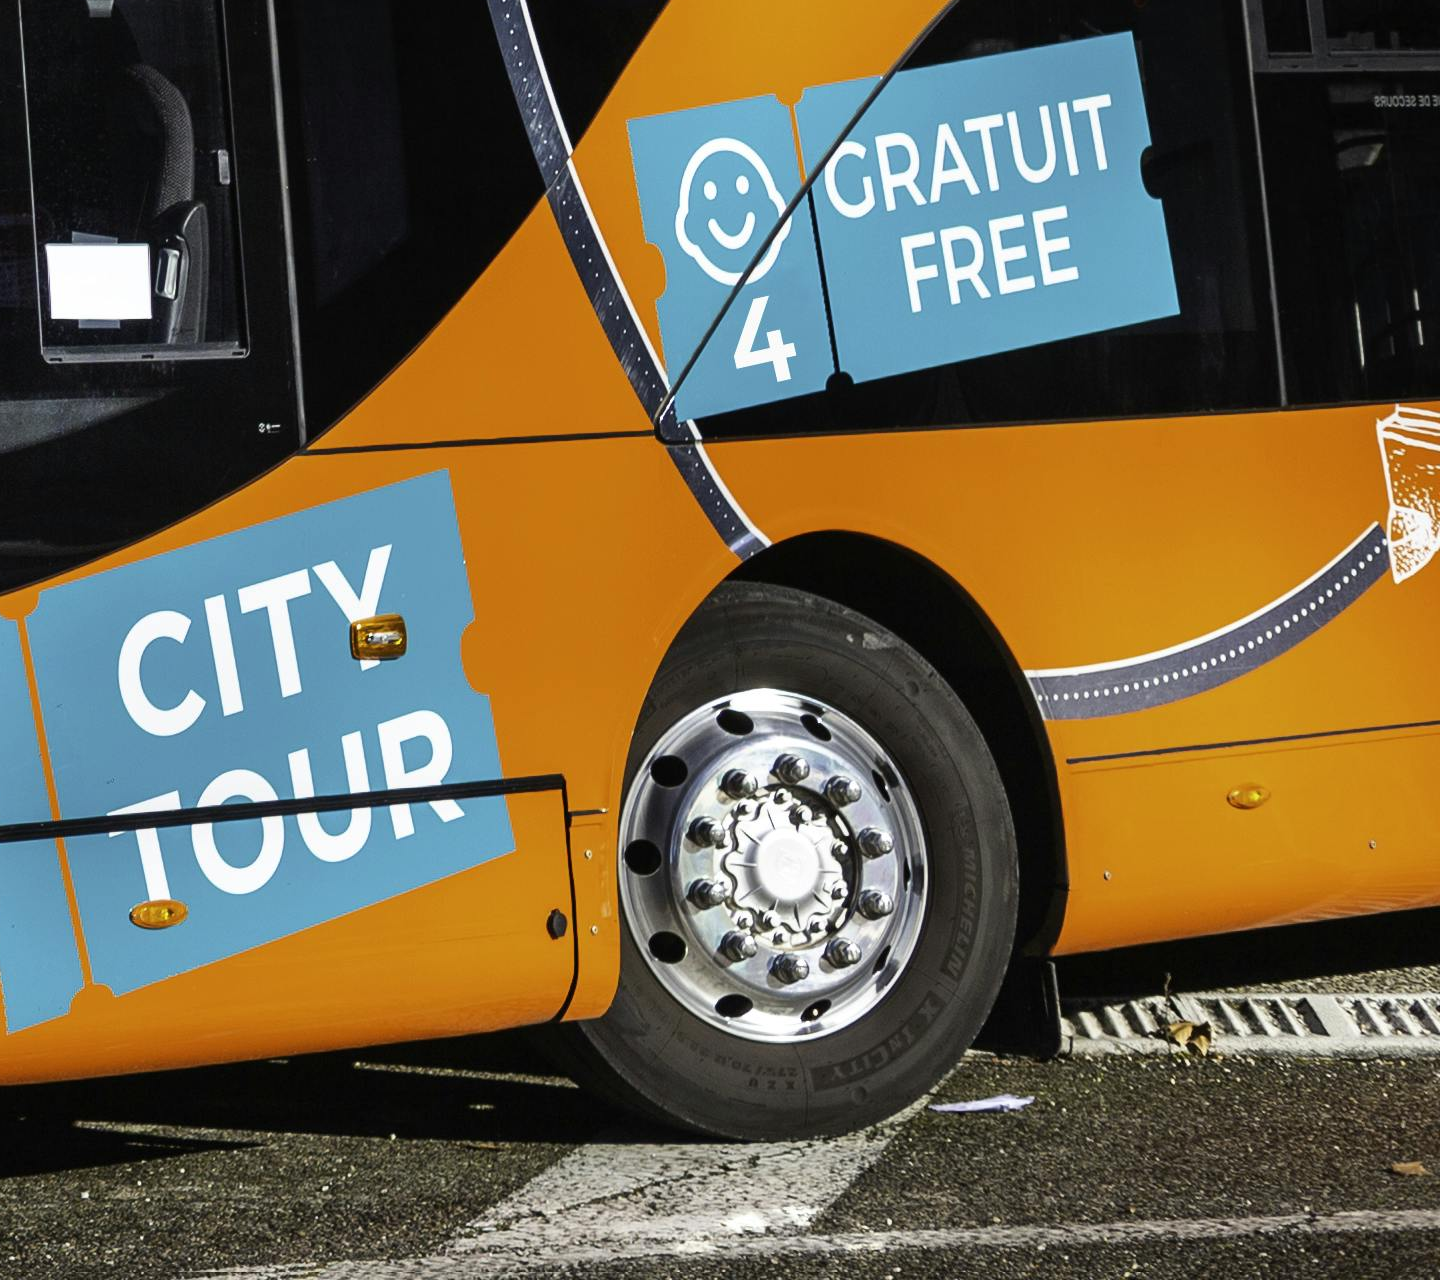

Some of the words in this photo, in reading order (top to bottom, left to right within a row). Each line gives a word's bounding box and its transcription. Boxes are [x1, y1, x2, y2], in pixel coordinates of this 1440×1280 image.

[824, 95, 1112, 218] GRATUIT
[900, 206, 1079, 313] FREE
[733, 296, 797, 382] 4
[118, 544, 392, 737] CITY
[107, 709, 465, 903] TOUR
[945, 847, 977, 978] MICHELIN
